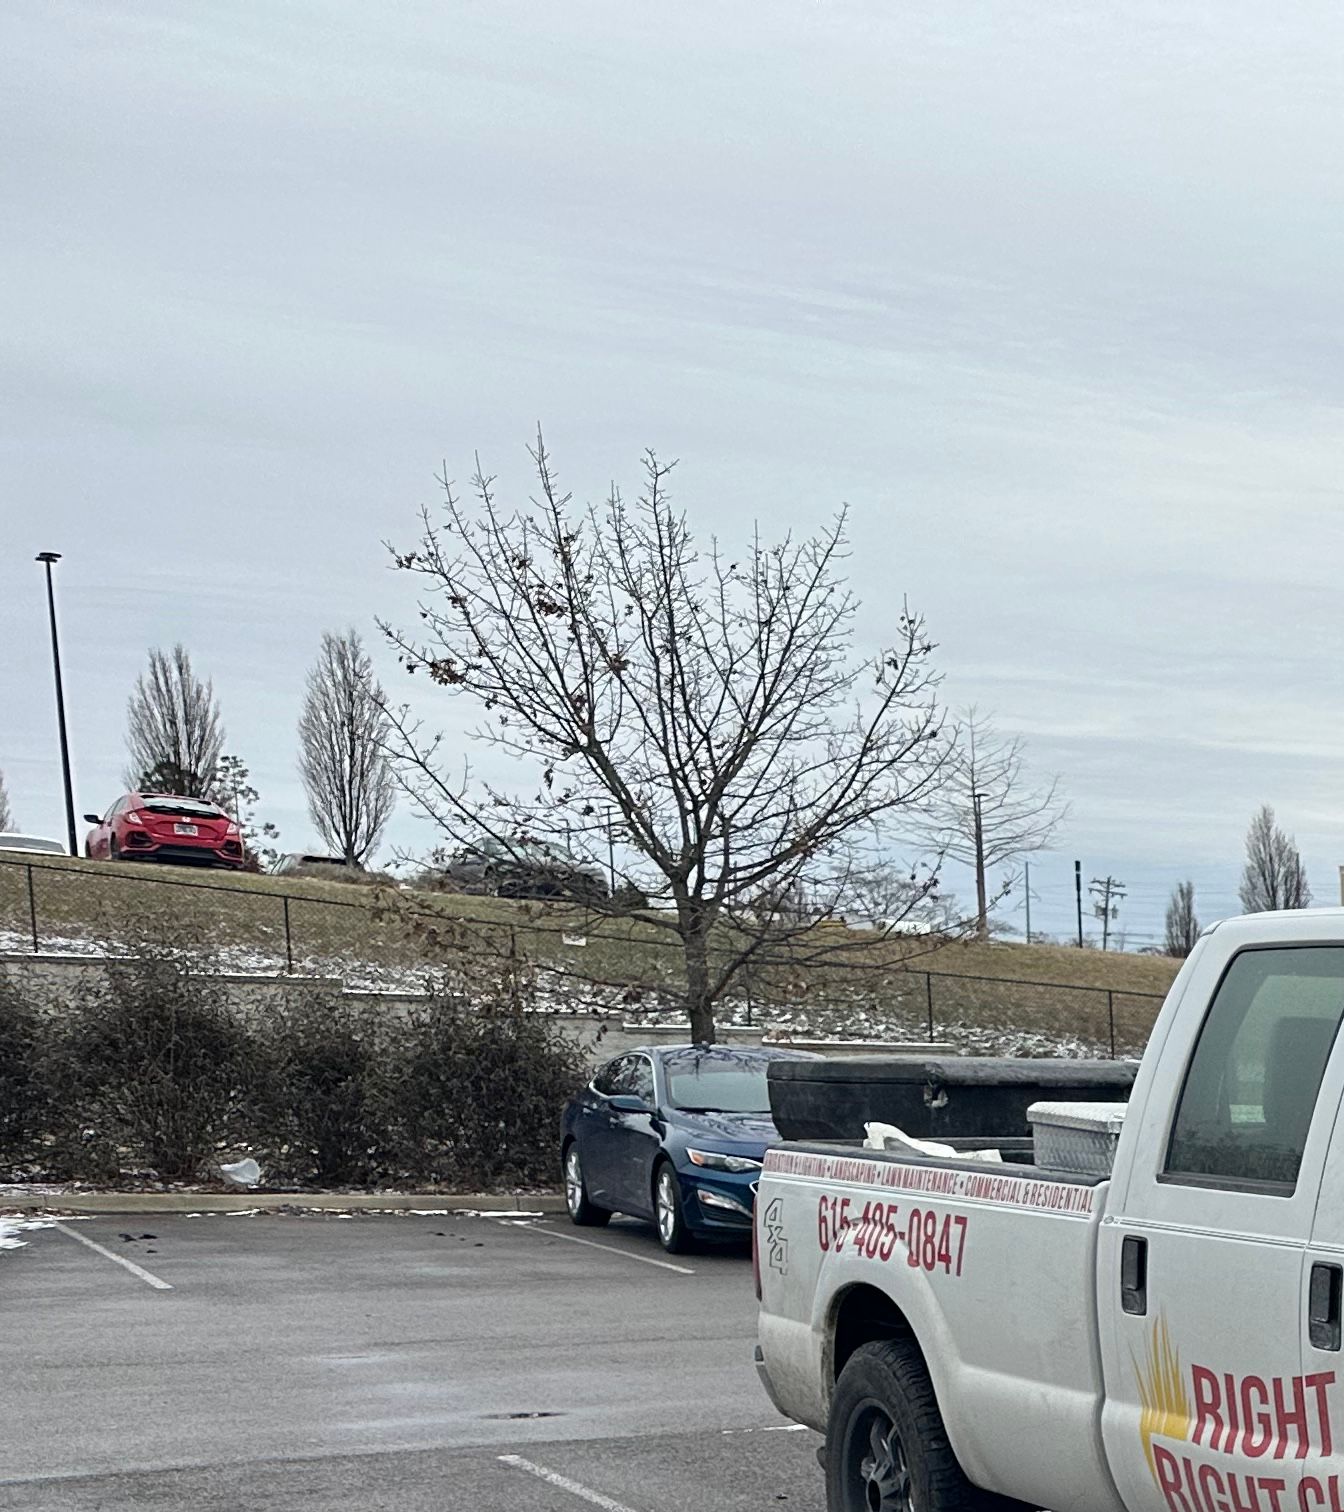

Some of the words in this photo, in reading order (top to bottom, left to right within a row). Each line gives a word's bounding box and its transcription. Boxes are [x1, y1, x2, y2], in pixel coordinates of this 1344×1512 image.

[902, 1168, 960, 1195] MAINTENANCE
[964, 1175, 1021, 1202] COMMERCIAL
[1022, 1184, 1029, 1205] &
[1029, 1183, 1095, 1213] RESIDENTIAL
[818, 1195, 968, 1277] 615-405-0847
[1191, 1362, 1336, 1460] RIGHT
